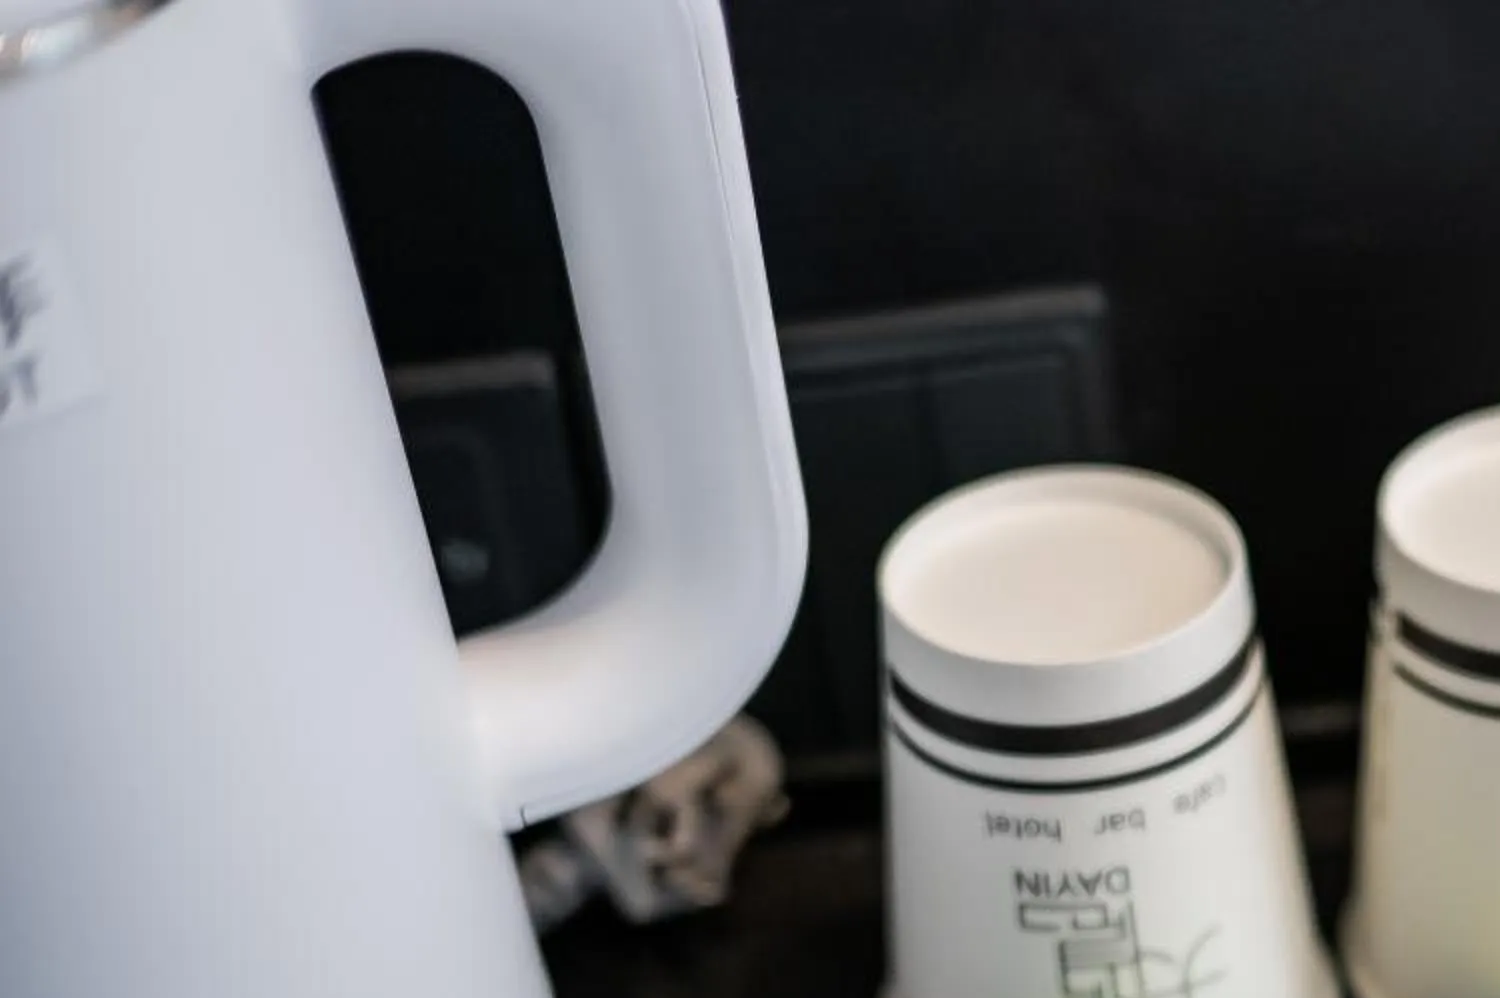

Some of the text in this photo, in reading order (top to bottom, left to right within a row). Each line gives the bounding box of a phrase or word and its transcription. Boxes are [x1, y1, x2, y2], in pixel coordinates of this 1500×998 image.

[984, 810, 1063, 842] hotel
[1094, 808, 1147, 836] bar
[1014, 866, 1131, 897] DAYIN
